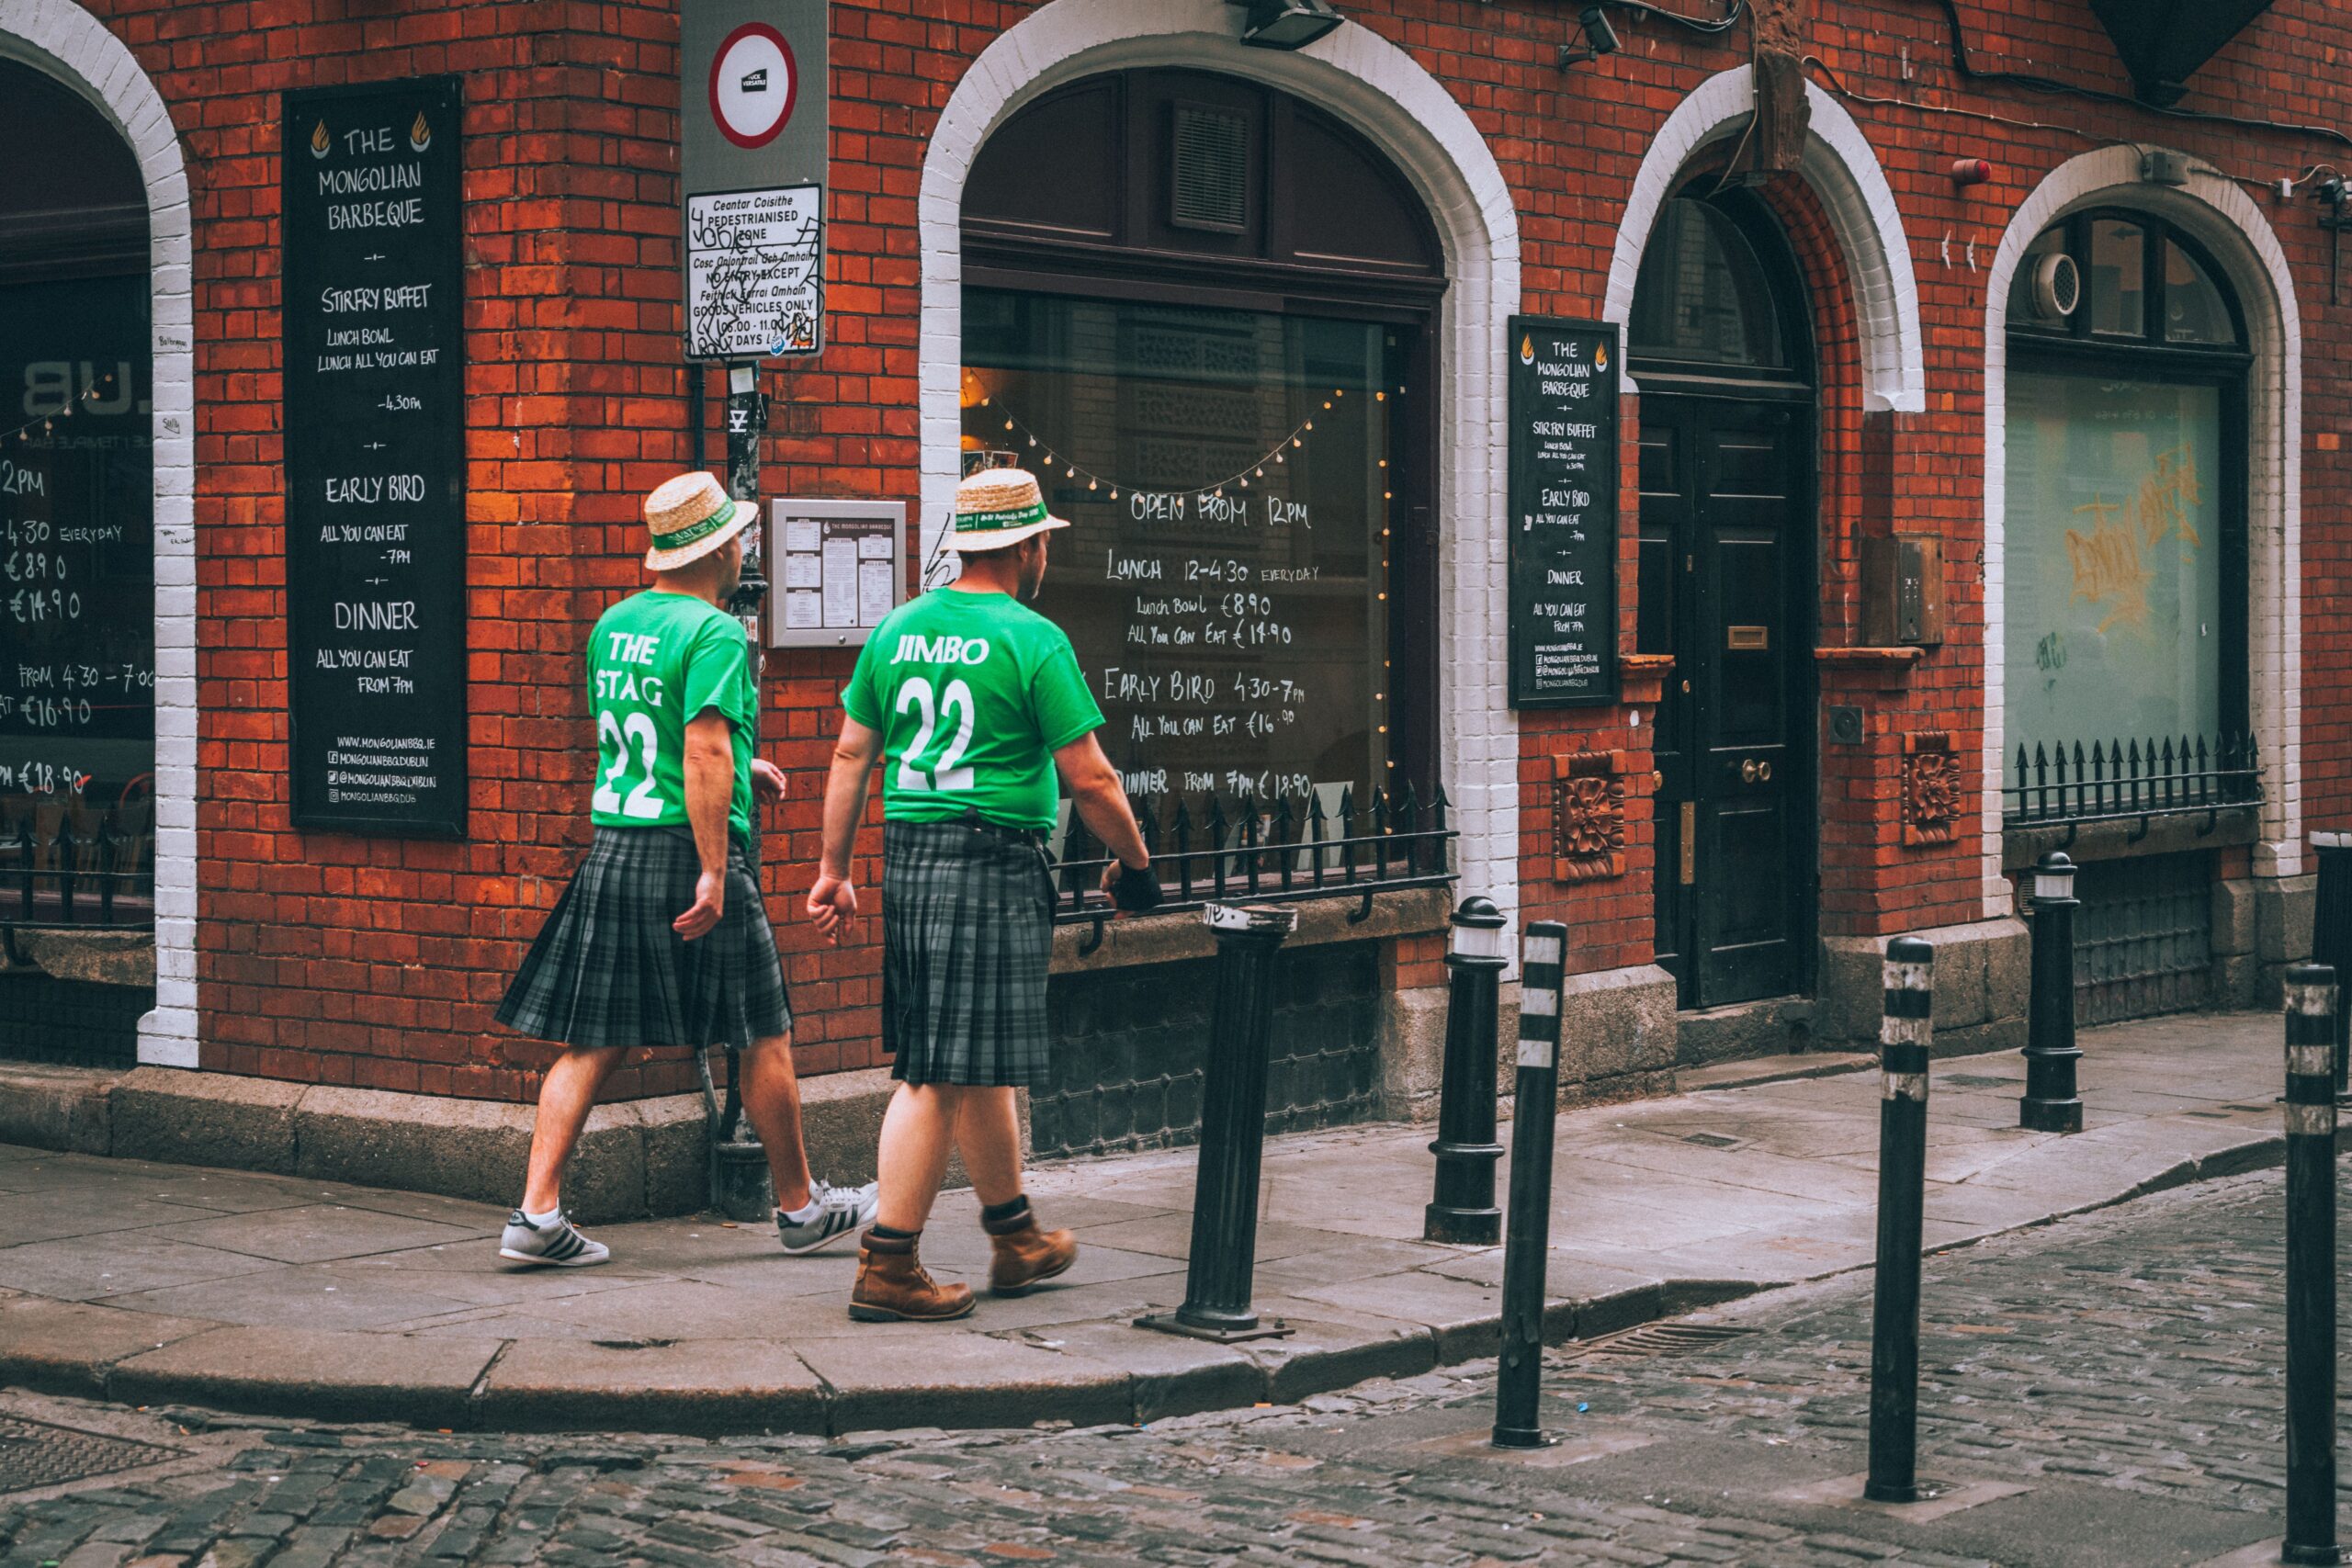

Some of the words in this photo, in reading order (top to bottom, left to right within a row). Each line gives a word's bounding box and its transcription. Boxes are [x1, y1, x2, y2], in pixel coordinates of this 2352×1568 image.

[344, 127, 395, 155] THE
[319, 162, 422, 196] MONGOLIAN
[714, 199, 751, 211] Ceantar
[754, 196, 793, 209] Coisithe
[328, 198, 424, 230] BARBEQUE
[707, 209, 798, 228] PEDESTRIANISED
[739, 228, 767, 241] ZONE
[694, 258, 714, 268] Cosc
[707, 272, 721, 284] NO
[761, 267, 800, 279] EXCEPT
[384, 283, 432, 311] BUFFET
[694, 304, 729, 317] GOODS
[731, 301, 782, 313] VEHICLES
[786, 299, 813, 311] ONLY
[327, 328, 359, 346] LUNCH
[362, 326, 394, 344] BOWL
[737, 333, 763, 345] DAYS
[1552, 342, 1578, 358] THE
[318, 354, 351, 372] LUNCH
[355, 353, 374, 369] ALL
[375, 351, 396, 367] YOU
[398, 350, 417, 366] CAN
[421, 349, 439, 365] EAT
[1537, 361, 1590, 378] MONGOLIAN
[1542, 380, 1590, 399] BARBEQUE
[1566, 423, 1598, 438] BUFFET
[1544, 441, 1558, 450] LUNCH
[1559, 441, 1573, 450] BOWL
[1567, 452, 1577, 460] CAN
[326, 477, 383, 503] EARLY
[389, 475, 425, 502] BIRD
[1542, 488, 1570, 507] EARLY
[1572, 490, 1589, 507] BIRD
[1131, 493, 1184, 521] OPEN
[1198, 494, 1247, 526] FROM
[1268, 495, 1311, 529] 12PM
[1535, 513, 1544, 524] ALL
[1545, 513, 1555, 524] YOU
[1556, 514, 1568, 525] CAN
[1568, 513, 1580, 525] EAT
[60, 525, 122, 544] EVERYDAY
[321, 525, 339, 543] ALL
[341, 525, 361, 542] YOU
[365, 525, 384, 542] CAN
[386, 524, 409, 541] EAT
[1107, 548, 1162, 580] LUNCH
[1261, 566, 1319, 581] EVERYDAY
[1547, 570, 1584, 585] DINNER
[1136, 596, 1170, 615] Lunch
[1220, 592, 1271, 617] €8.90
[1533, 603, 1543, 615] ALL
[1544, 603, 1558, 616] YOU
[1559, 603, 1573, 616] CAN
[1574, 603, 1587, 616] EAT
[334, 601, 419, 631] DINNER
[1127, 625, 1148, 644] ALL
[1174, 626, 1195, 644] CAN
[1204, 622, 1227, 644] EAT
[1554, 620, 1570, 633] FROM
[608, 632, 661, 665] THE
[889, 634, 989, 665] JIMBO
[316, 649, 338, 668] ALL
[339, 649, 362, 668] YOU
[364, 649, 386, 668] CAN
[389, 649, 413, 668] EAT
[18, 663, 54, 688] FROM
[357, 677, 390, 694] FROM
[391, 676, 413, 694] 7PM
[595, 669, 664, 707] STAG
[1104, 667, 1160, 702] EARLY
[1170, 671, 1215, 705] BIRD
[896, 676, 975, 792] 22
[1132, 714, 1151, 742] ALL
[1182, 717, 1204, 735] CAN
[1213, 714, 1237, 737] EAT
[337, 737, 435, 750] WWW.MONGOLIANBBQ.IE
[340, 753, 428, 767] MONGOLIANBBQDUBLIN
[592, 709, 664, 819] 22
[1184, 771, 1215, 792] FROM
